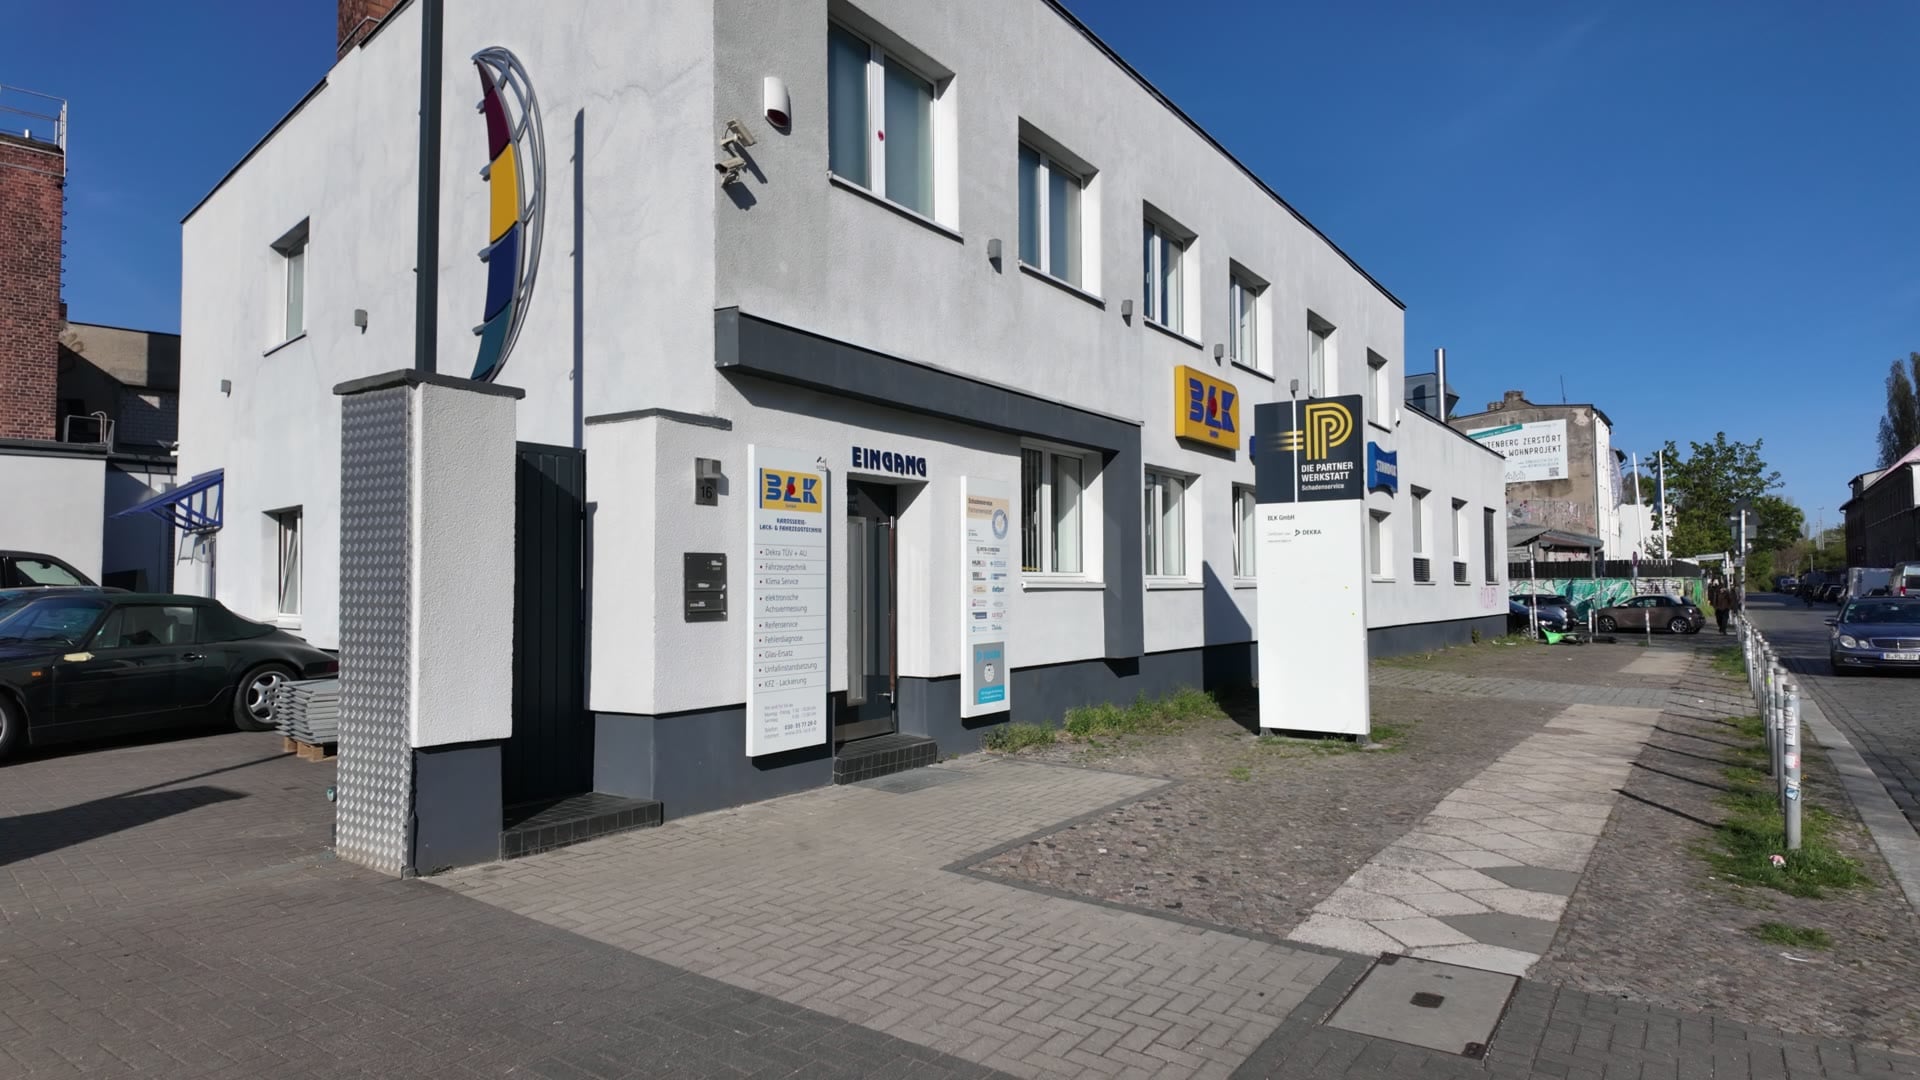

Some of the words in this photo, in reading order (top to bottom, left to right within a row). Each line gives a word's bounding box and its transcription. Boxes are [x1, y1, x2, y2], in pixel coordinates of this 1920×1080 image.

[1188, 377, 1236, 433] BLK
[1509, 445, 1560, 456] WOHNPROJEKT
[852, 446, 926, 477] EINGANG
[1301, 463, 1315, 473] DIE
[1316, 461, 1354, 472] PARTNER
[1301, 471, 1350, 482] WERKSTATT
[700, 486, 714, 499] 16
[765, 474, 817, 504] BLK
[1301, 483, 1345, 491] Schadenservice
